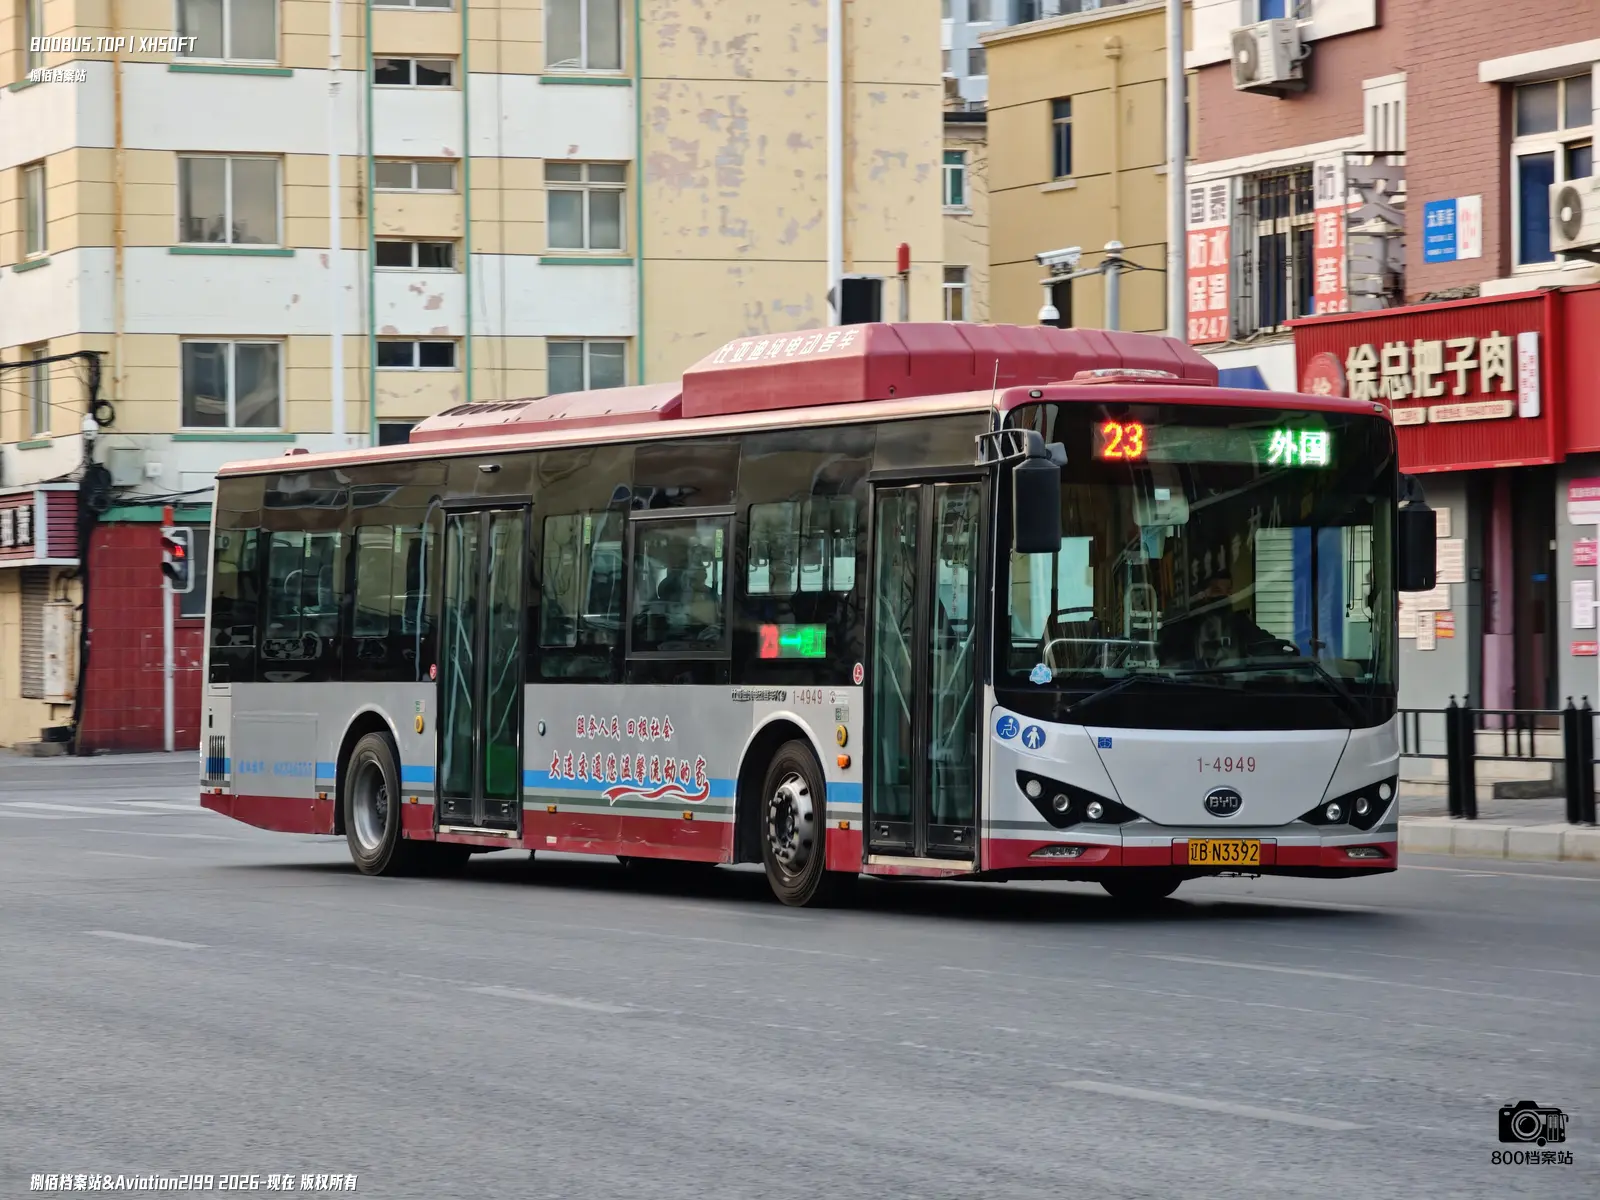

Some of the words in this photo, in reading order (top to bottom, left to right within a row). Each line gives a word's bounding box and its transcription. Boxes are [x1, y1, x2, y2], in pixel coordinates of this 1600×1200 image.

[1188, 230, 1229, 268] 防水
[1188, 273, 1228, 312] 保温
[1187, 316, 1228, 340] 8247
[712, 329, 860, 364] 比亚迪纯电动客车
[1345, 330, 1514, 401] 徐总把子肉
[1102, 422, 1145, 459] 23
[1267, 429, 1329, 466] 外国
[793, 689, 823, 704] 1-4949
[576, 715, 620, 741] 服务人民
[626, 715, 674, 741] 回报社会
[549, 750, 707, 789] 大连交通您温馨流动的家
[1197, 756, 1256, 773] 1-4949
[1209, 796, 1239, 808] BYD
